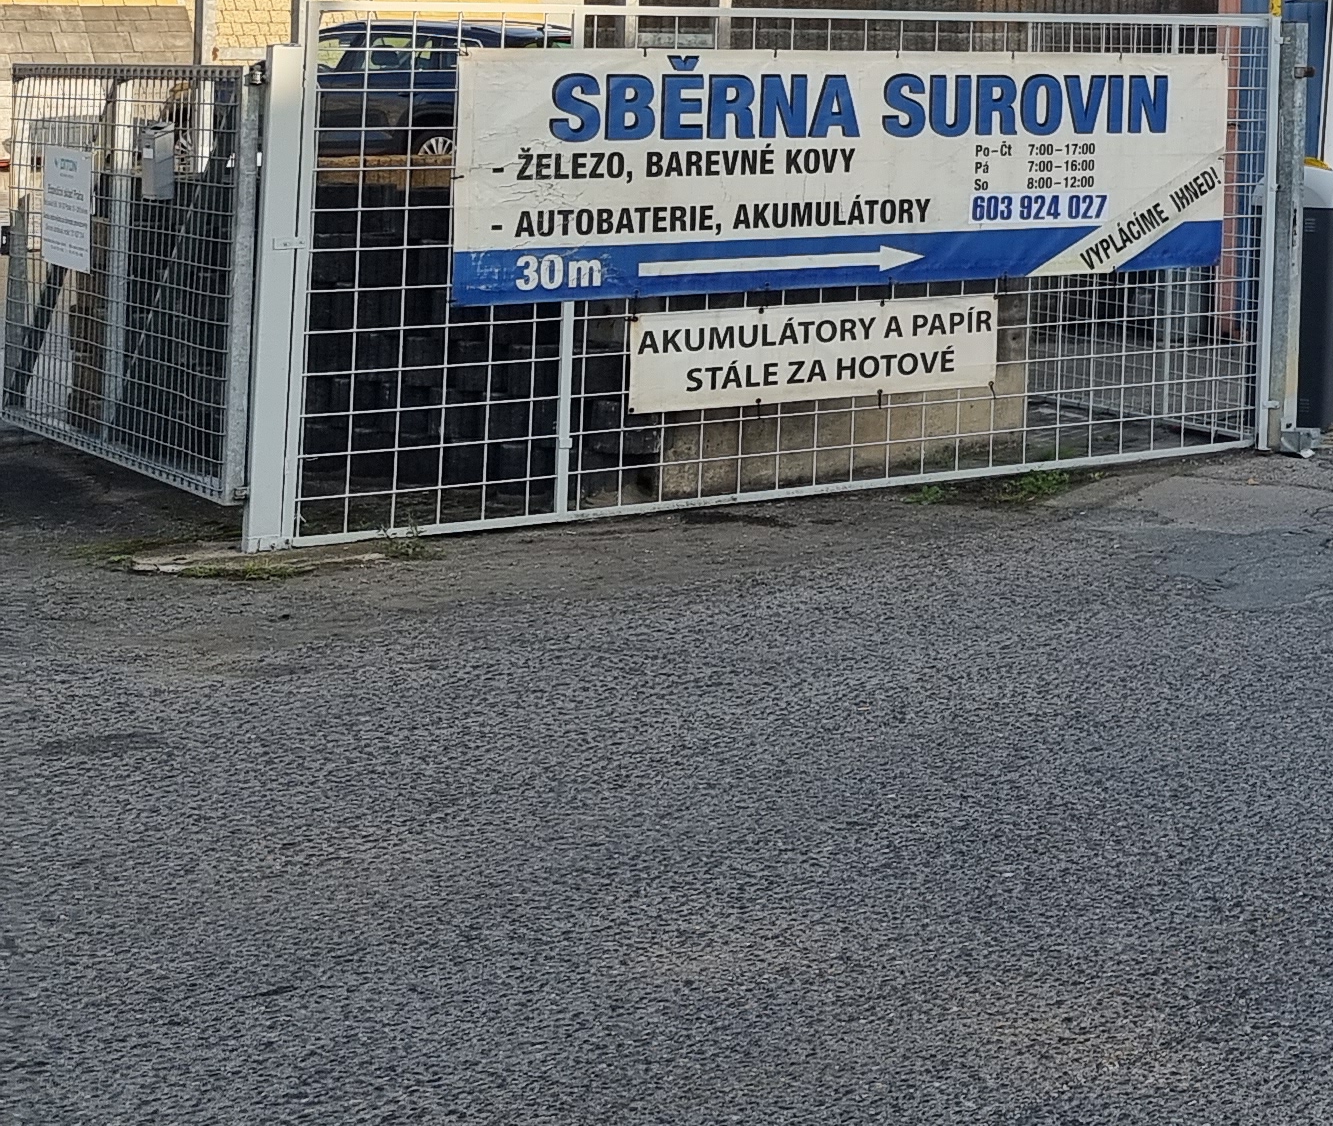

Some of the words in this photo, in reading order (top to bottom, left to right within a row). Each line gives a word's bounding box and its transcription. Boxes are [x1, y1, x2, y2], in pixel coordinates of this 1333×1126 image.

[548, 55, 861, 143] SBĚRNA
[881, 73, 1169, 139] SUROVIN
[515, 147, 633, 184] ŽELEZO,
[645, 143, 775, 179] BAREVNÉ
[785, 148, 856, 175] KOVY
[974, 178, 989, 192] So
[975, 161, 990, 175] Pá
[514, 204, 722, 238] AUTOBATERIE,
[732, 194, 931, 230] AKUMULÁTORY
[971, 195, 1013, 222] 603
[1019, 194, 1061, 221] 924
[1067, 194, 1108, 220] 027
[1079, 202, 1170, 270] VYPLÁCÍME
[1169, 165, 1223, 213] IHNED!
[637, 316, 876, 355] AKUMULÁTORY
[884, 315, 903, 338] A
[912, 305, 992, 335] PAPÍR
[686, 360, 779, 392] STÁLE
[787, 360, 826, 385] ZA
[836, 345, 955, 381] HOTOVÉ
